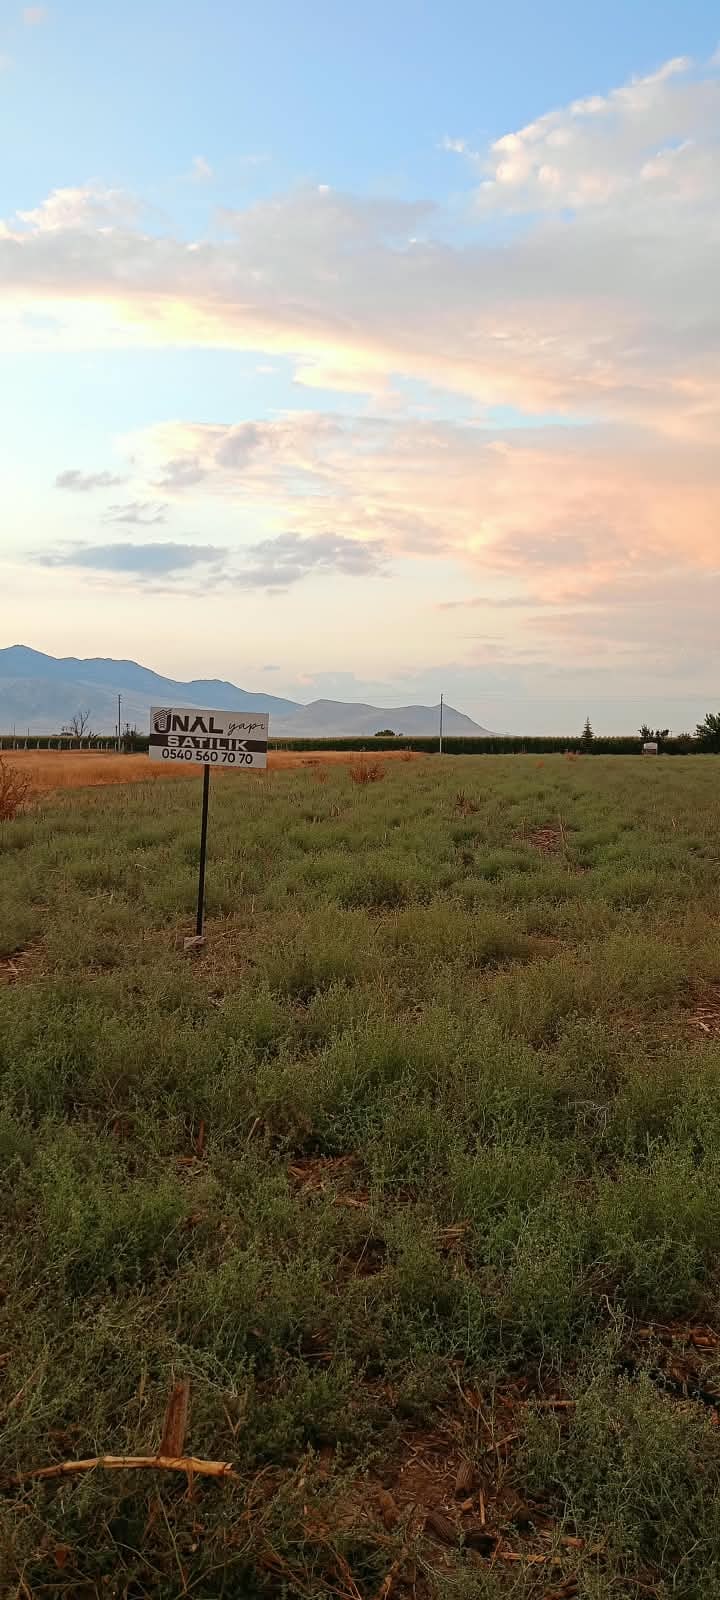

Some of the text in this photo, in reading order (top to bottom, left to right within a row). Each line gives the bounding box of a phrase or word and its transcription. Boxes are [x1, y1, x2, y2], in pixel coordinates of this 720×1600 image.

[167, 736, 249, 751] SATILIK
[162, 748, 253, 765] 0540 560 70 70
